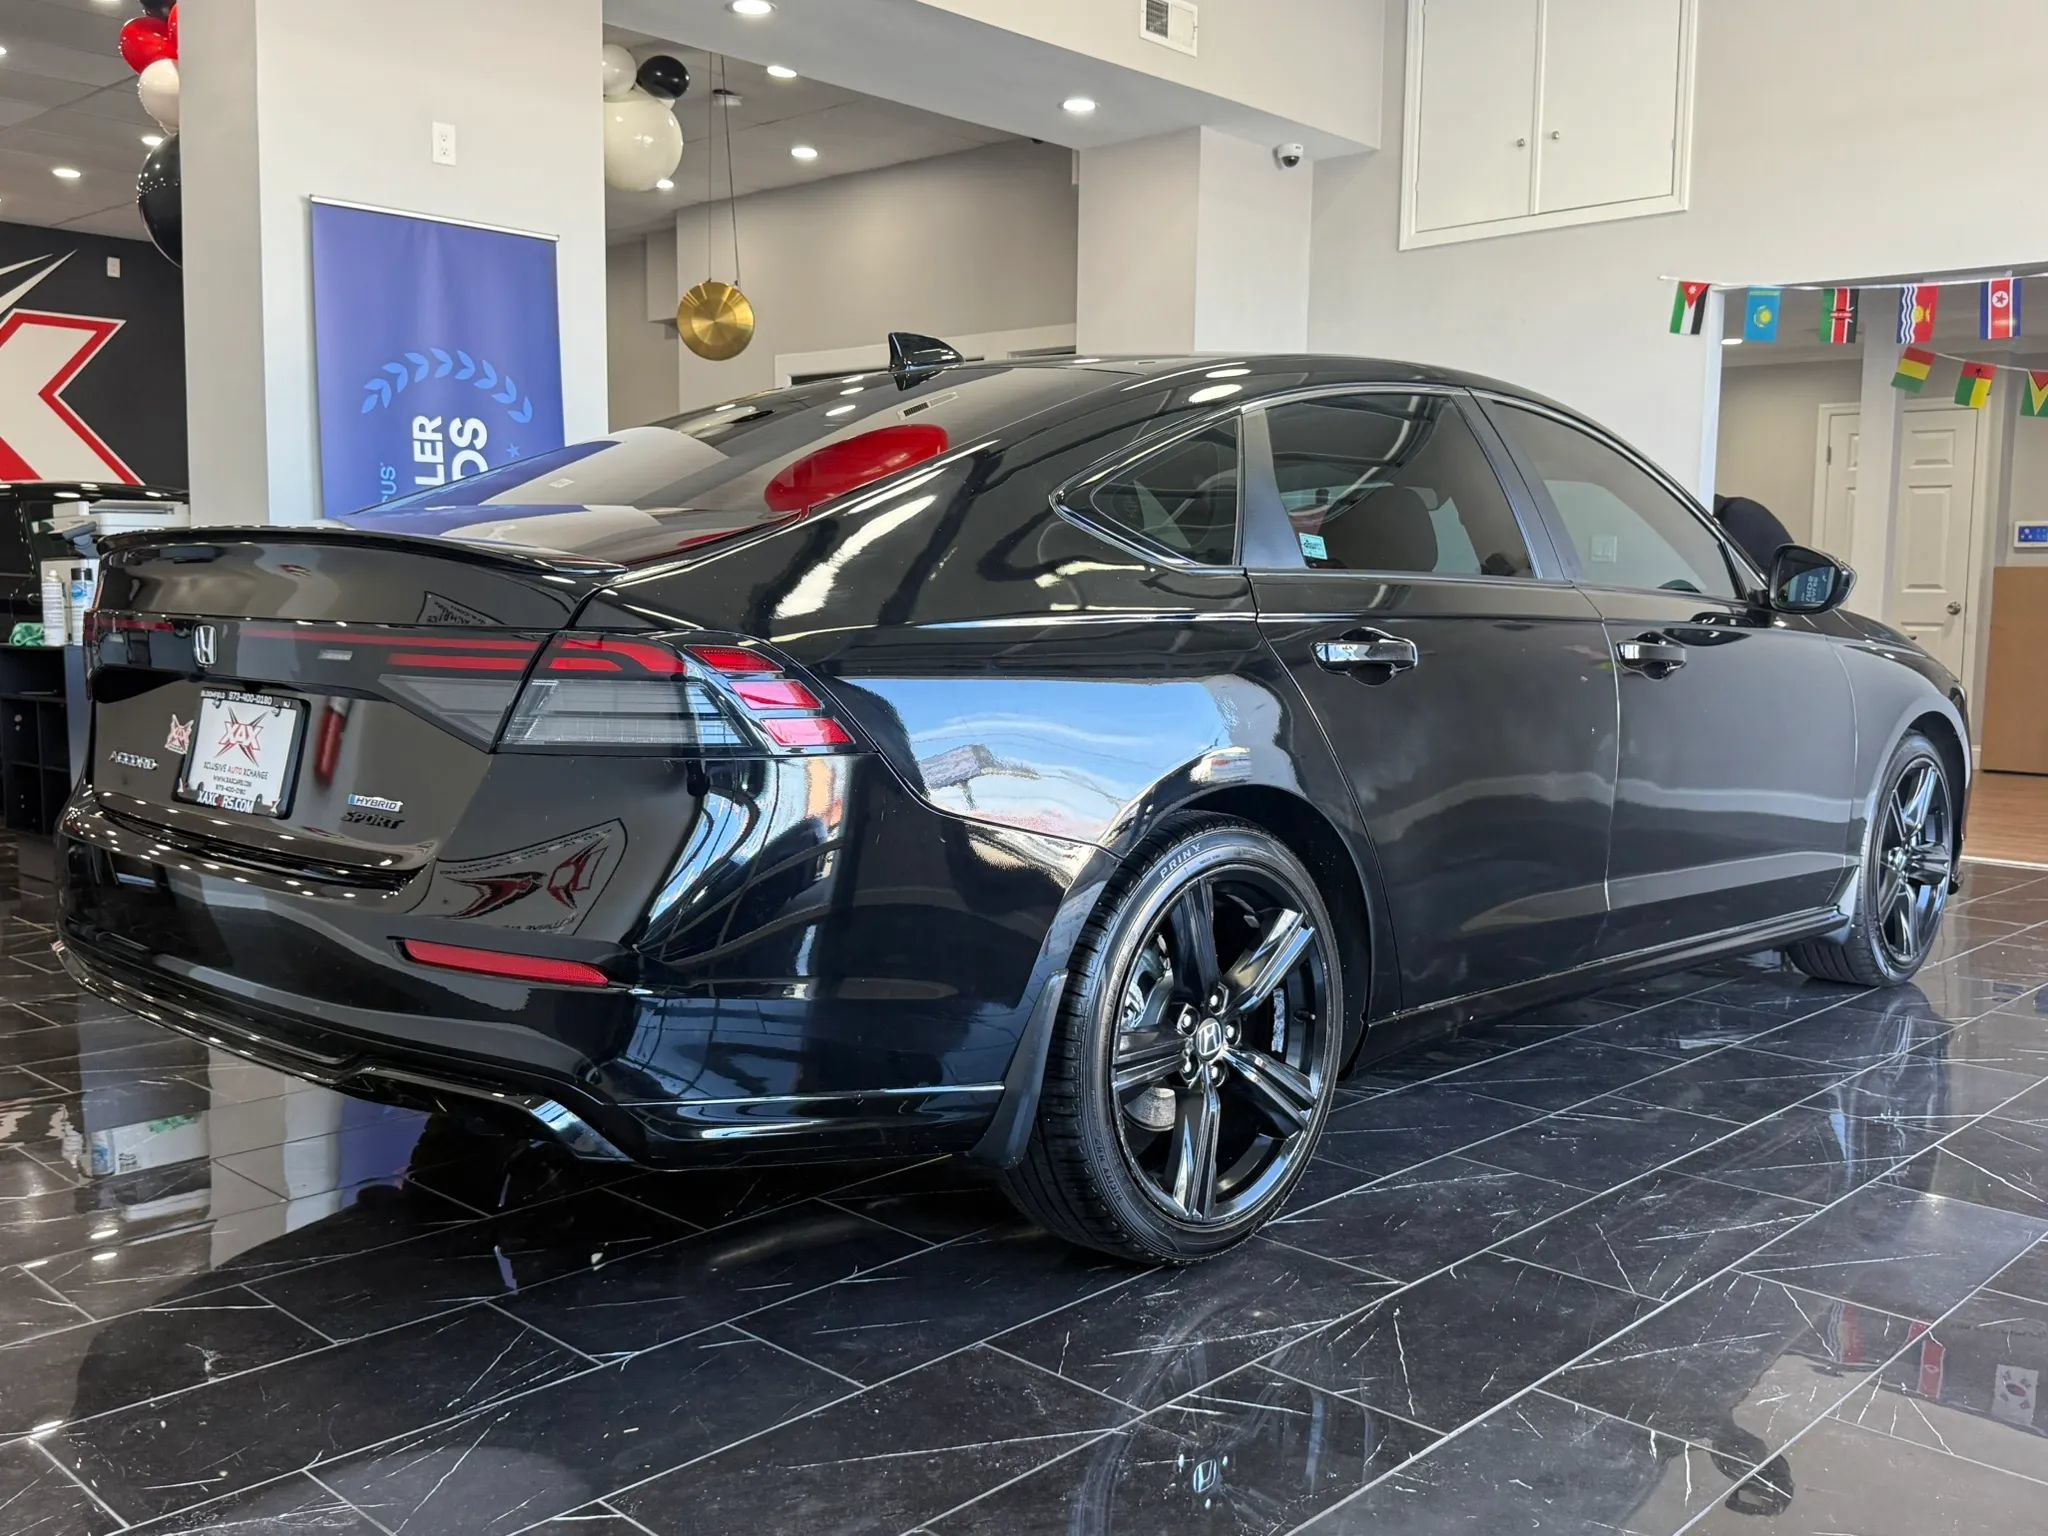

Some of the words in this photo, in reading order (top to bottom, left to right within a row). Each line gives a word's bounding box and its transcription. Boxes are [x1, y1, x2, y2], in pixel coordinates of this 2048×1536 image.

[228, 691, 273, 706] 973-400-0180
[203, 761, 227, 773] XCLUSIVE
[227, 765, 243, 775] AUTO
[243, 768, 269, 780] XCHANGE
[354, 796, 399, 811] HYBRID
[341, 810, 405, 830] SPORT
[1159, 842, 1201, 879] PRINX
